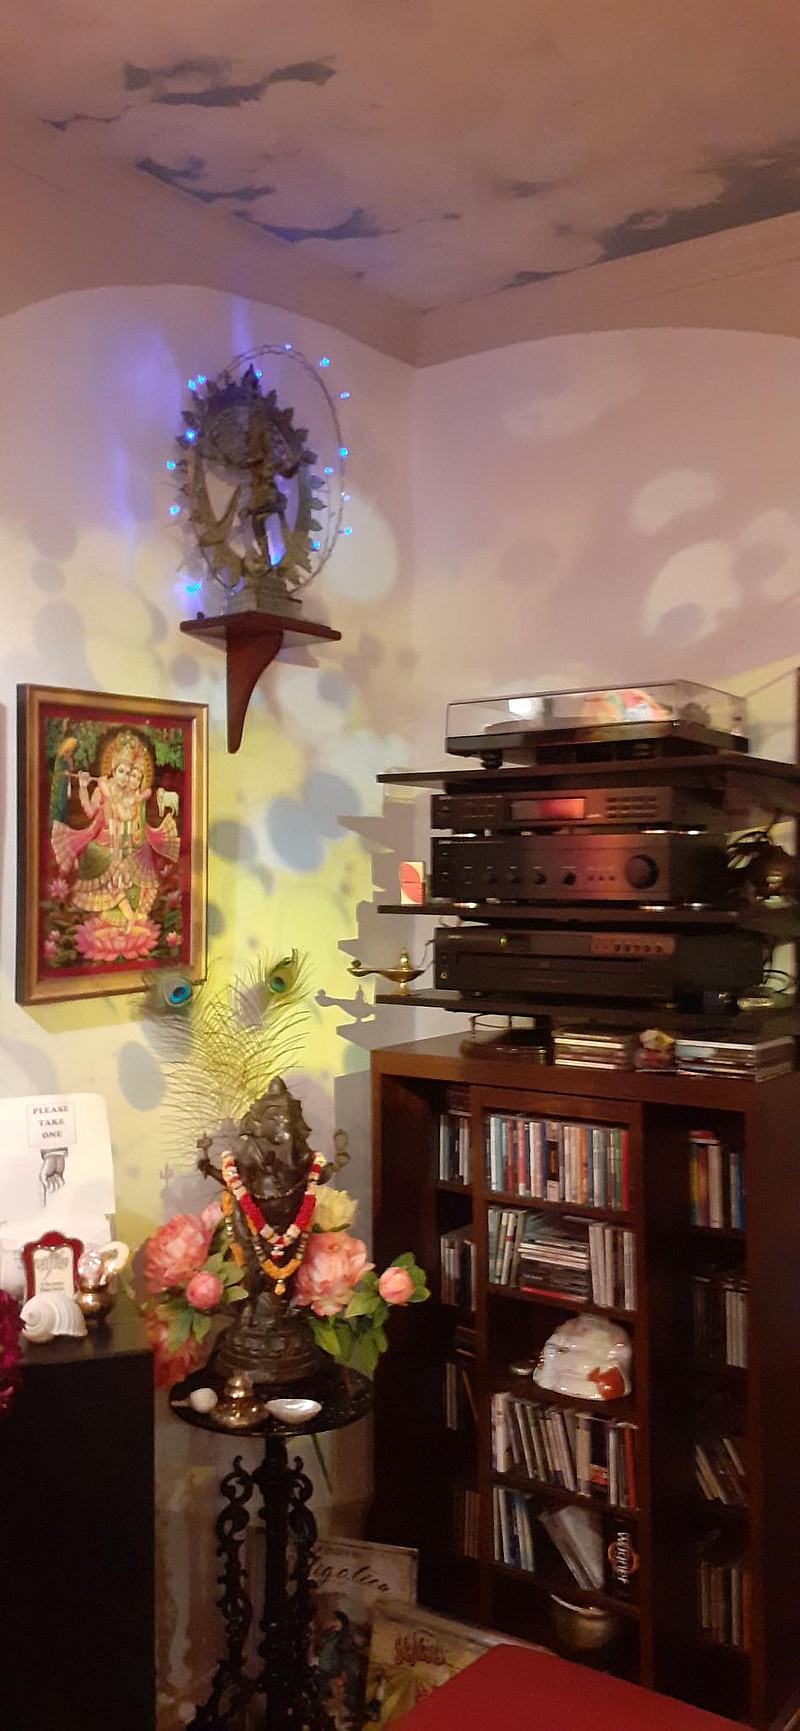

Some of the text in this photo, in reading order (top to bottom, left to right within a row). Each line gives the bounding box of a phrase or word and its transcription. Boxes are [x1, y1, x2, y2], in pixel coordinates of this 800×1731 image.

[33, 1106, 68, 1114] PLEASE
[39, 1118, 65, 1126] TAKE
[42, 1131, 62, 1139] ONE
